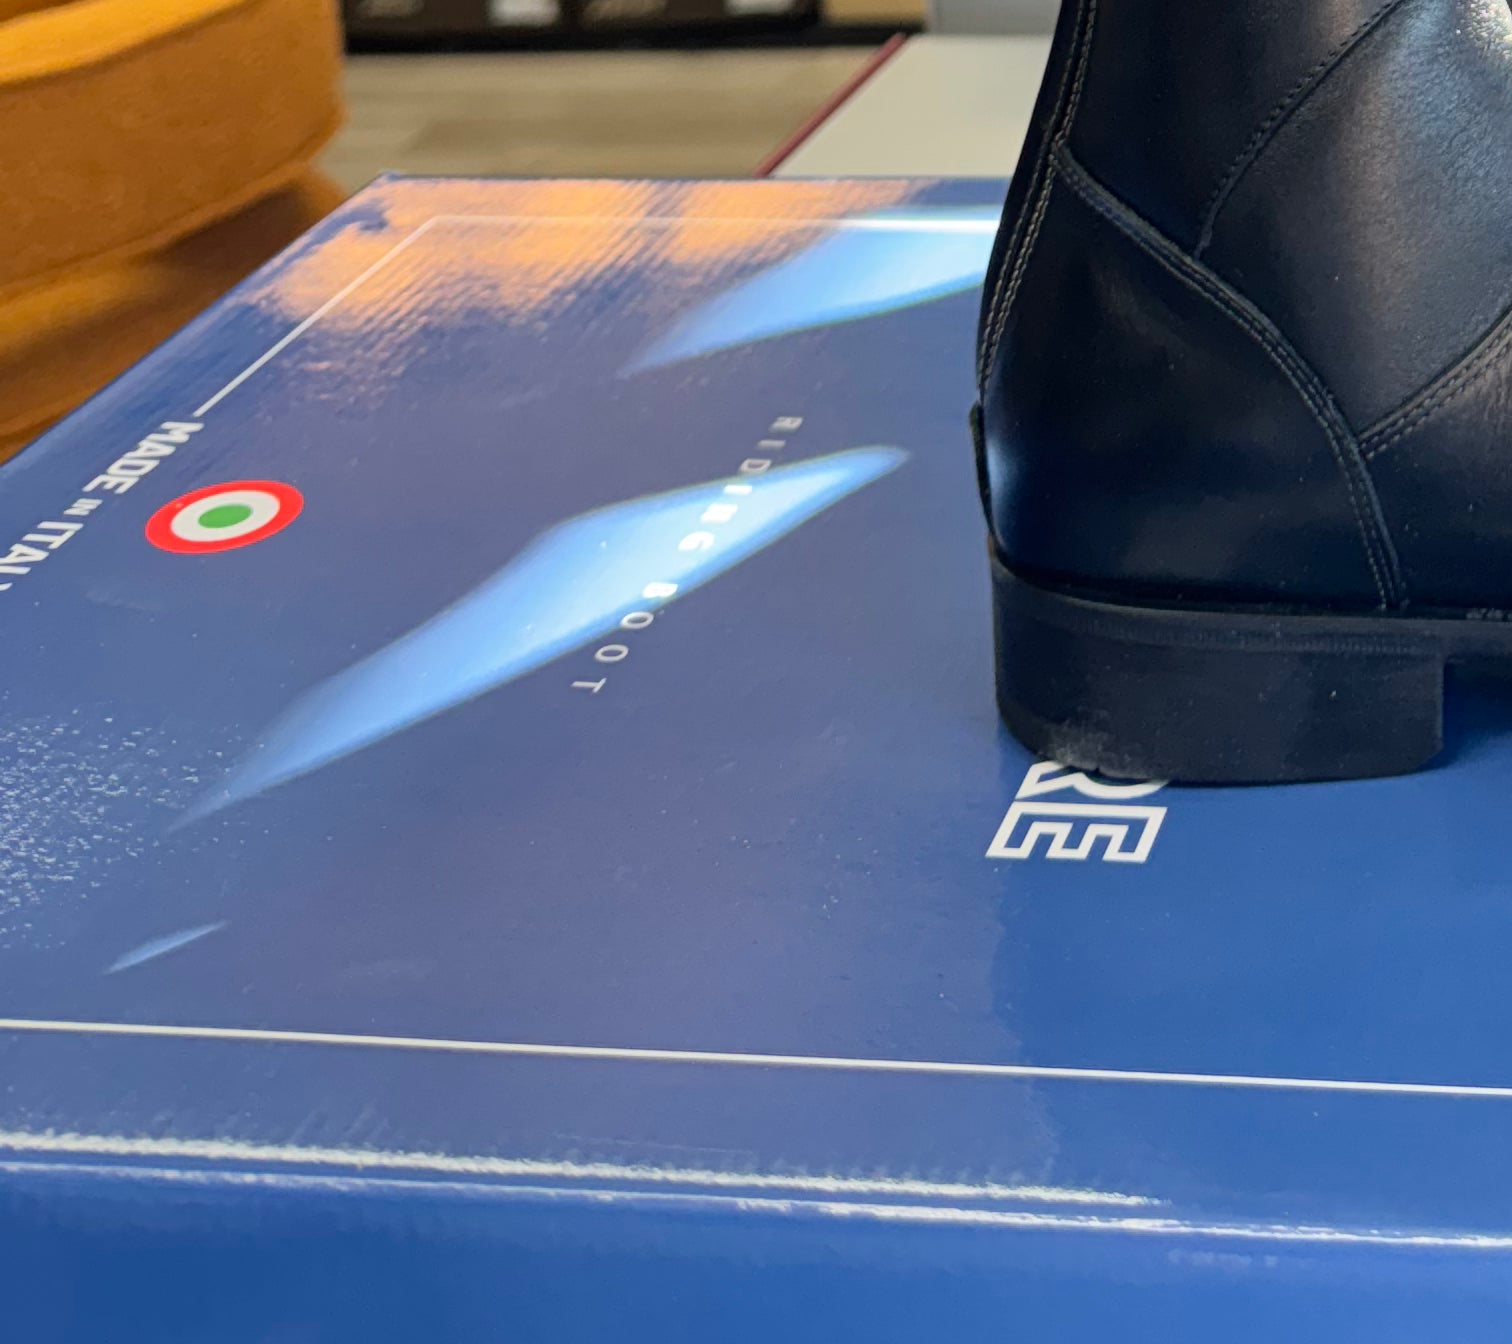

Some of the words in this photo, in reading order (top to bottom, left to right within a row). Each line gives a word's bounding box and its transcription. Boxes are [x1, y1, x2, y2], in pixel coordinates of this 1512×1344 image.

[82, 421, 205, 495] MADE
[63, 498, 104, 516] IN
[570, 581, 679, 694] BOOT
